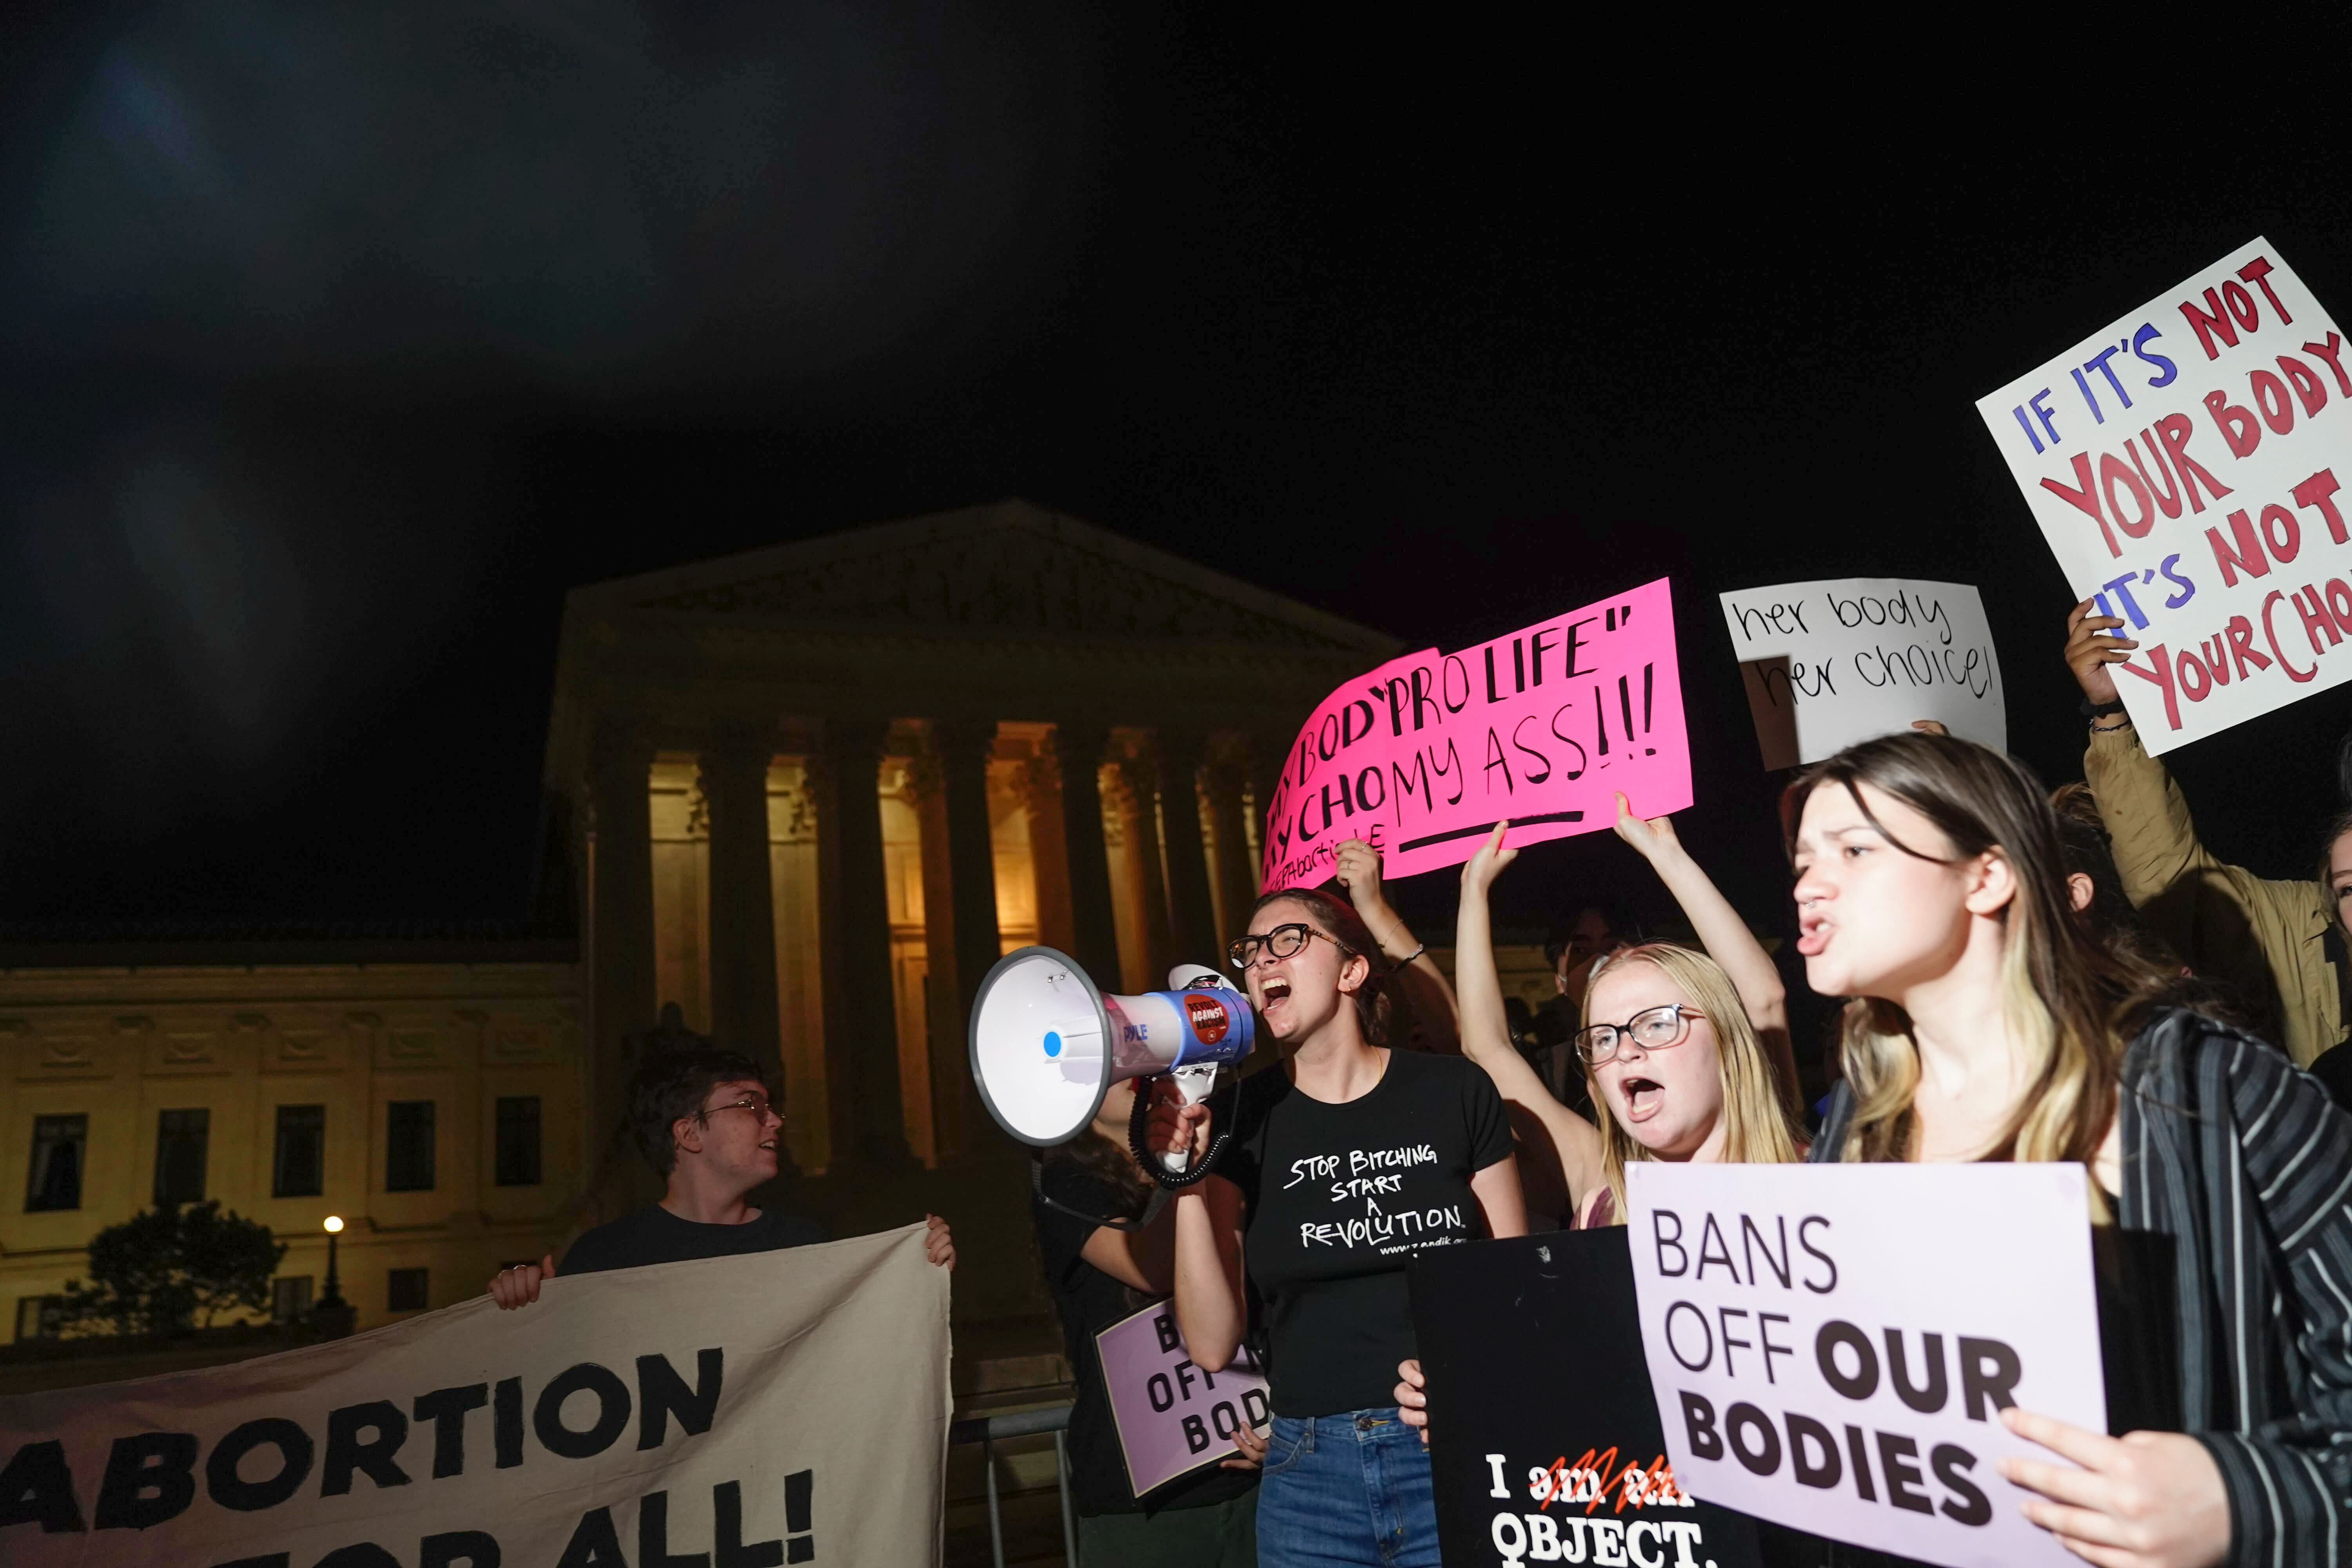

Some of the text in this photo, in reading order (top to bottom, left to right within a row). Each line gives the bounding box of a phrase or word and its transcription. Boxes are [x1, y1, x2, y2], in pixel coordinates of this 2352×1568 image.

[2012, 256, 2293, 455] IF IT'S NOT
[2039, 330, 2352, 559] YOUR BODY
[2093, 467, 2350, 639] IT'S NOT
[1732, 590, 1951, 645] her body
[2120, 569, 2352, 731] YOUR CHO
[1755, 657, 1837, 706] her
[1299, 686, 1384, 788] BOD
[1392, 662, 1656, 827] MY ASS!!!
[1287, 838, 1341, 886] Aborti
[1123, 1024, 1148, 1043] PYLE
[1187, 1000, 1217, 1012] REVOLT
[1192, 1007, 1224, 1022] AGAINST
[1283, 1144, 1437, 1189] STOP BITCHING
[1331, 1174, 1402, 1202] START
[1367, 1197, 1382, 1216] A
[1652, 1209, 1838, 1294] BANS
[1665, 1300, 2022, 1422] OFF OUR
[0, 1347, 723, 1533] ABORTION
[1486, 1454, 1511, 1499] I
[1678, 1389, 1993, 1527] BODIES
[556, 1469, 815, 1568] ALL!
